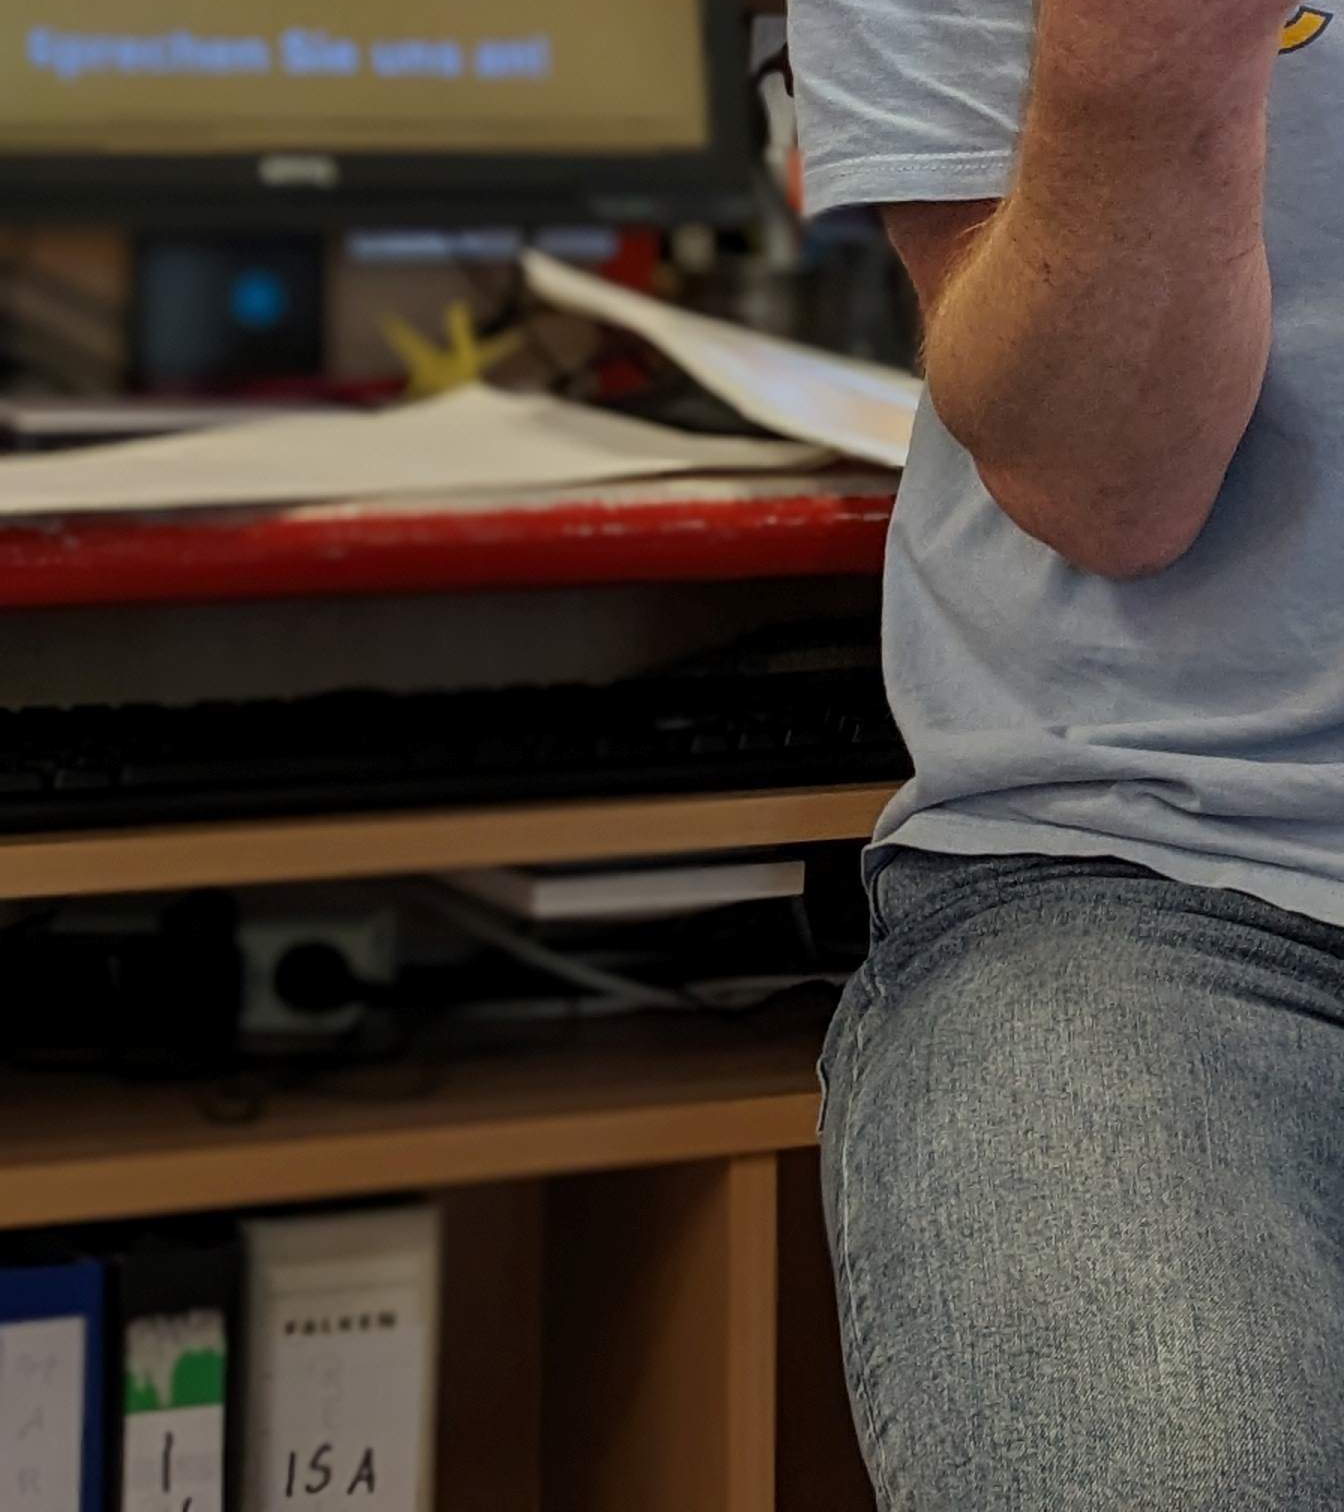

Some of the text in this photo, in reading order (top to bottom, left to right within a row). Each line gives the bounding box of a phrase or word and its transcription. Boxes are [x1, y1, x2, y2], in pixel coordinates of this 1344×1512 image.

[30, 30, 268, 79] Sprechen
[281, 31, 358, 77] Sie
[284, 1311, 398, 1336] FALKEN
